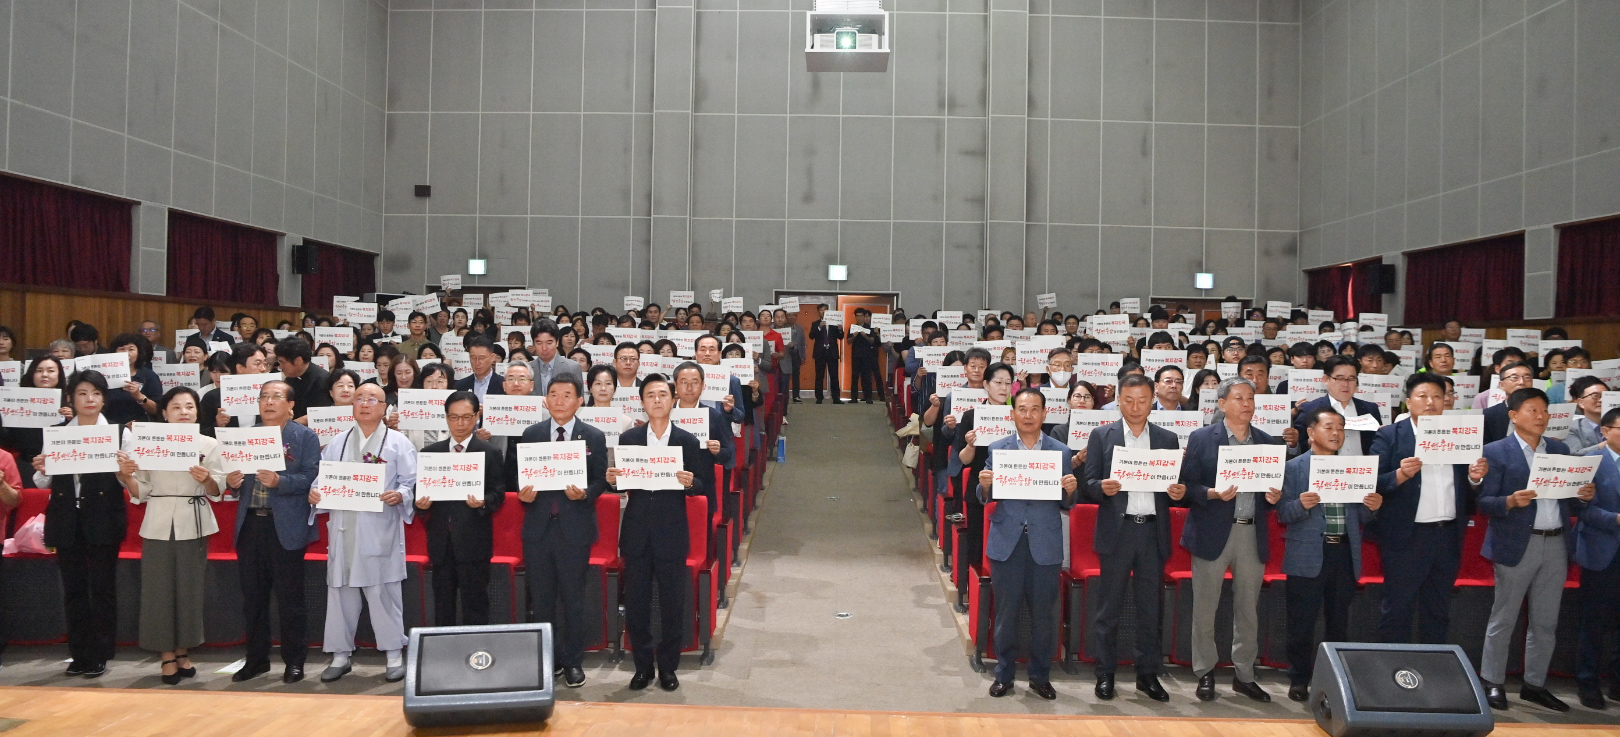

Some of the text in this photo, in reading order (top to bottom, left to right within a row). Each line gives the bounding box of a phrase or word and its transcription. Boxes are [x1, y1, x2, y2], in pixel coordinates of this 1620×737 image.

[1452, 427, 1478, 435] 복지강국
[83, 436, 112, 444] 복지강국
[1149, 459, 1176, 467] 복지강국
[1252, 456, 1279, 464] 복지강국
[453, 463, 479, 471] 복지강국
[353, 474, 378, 483] 복지강국
